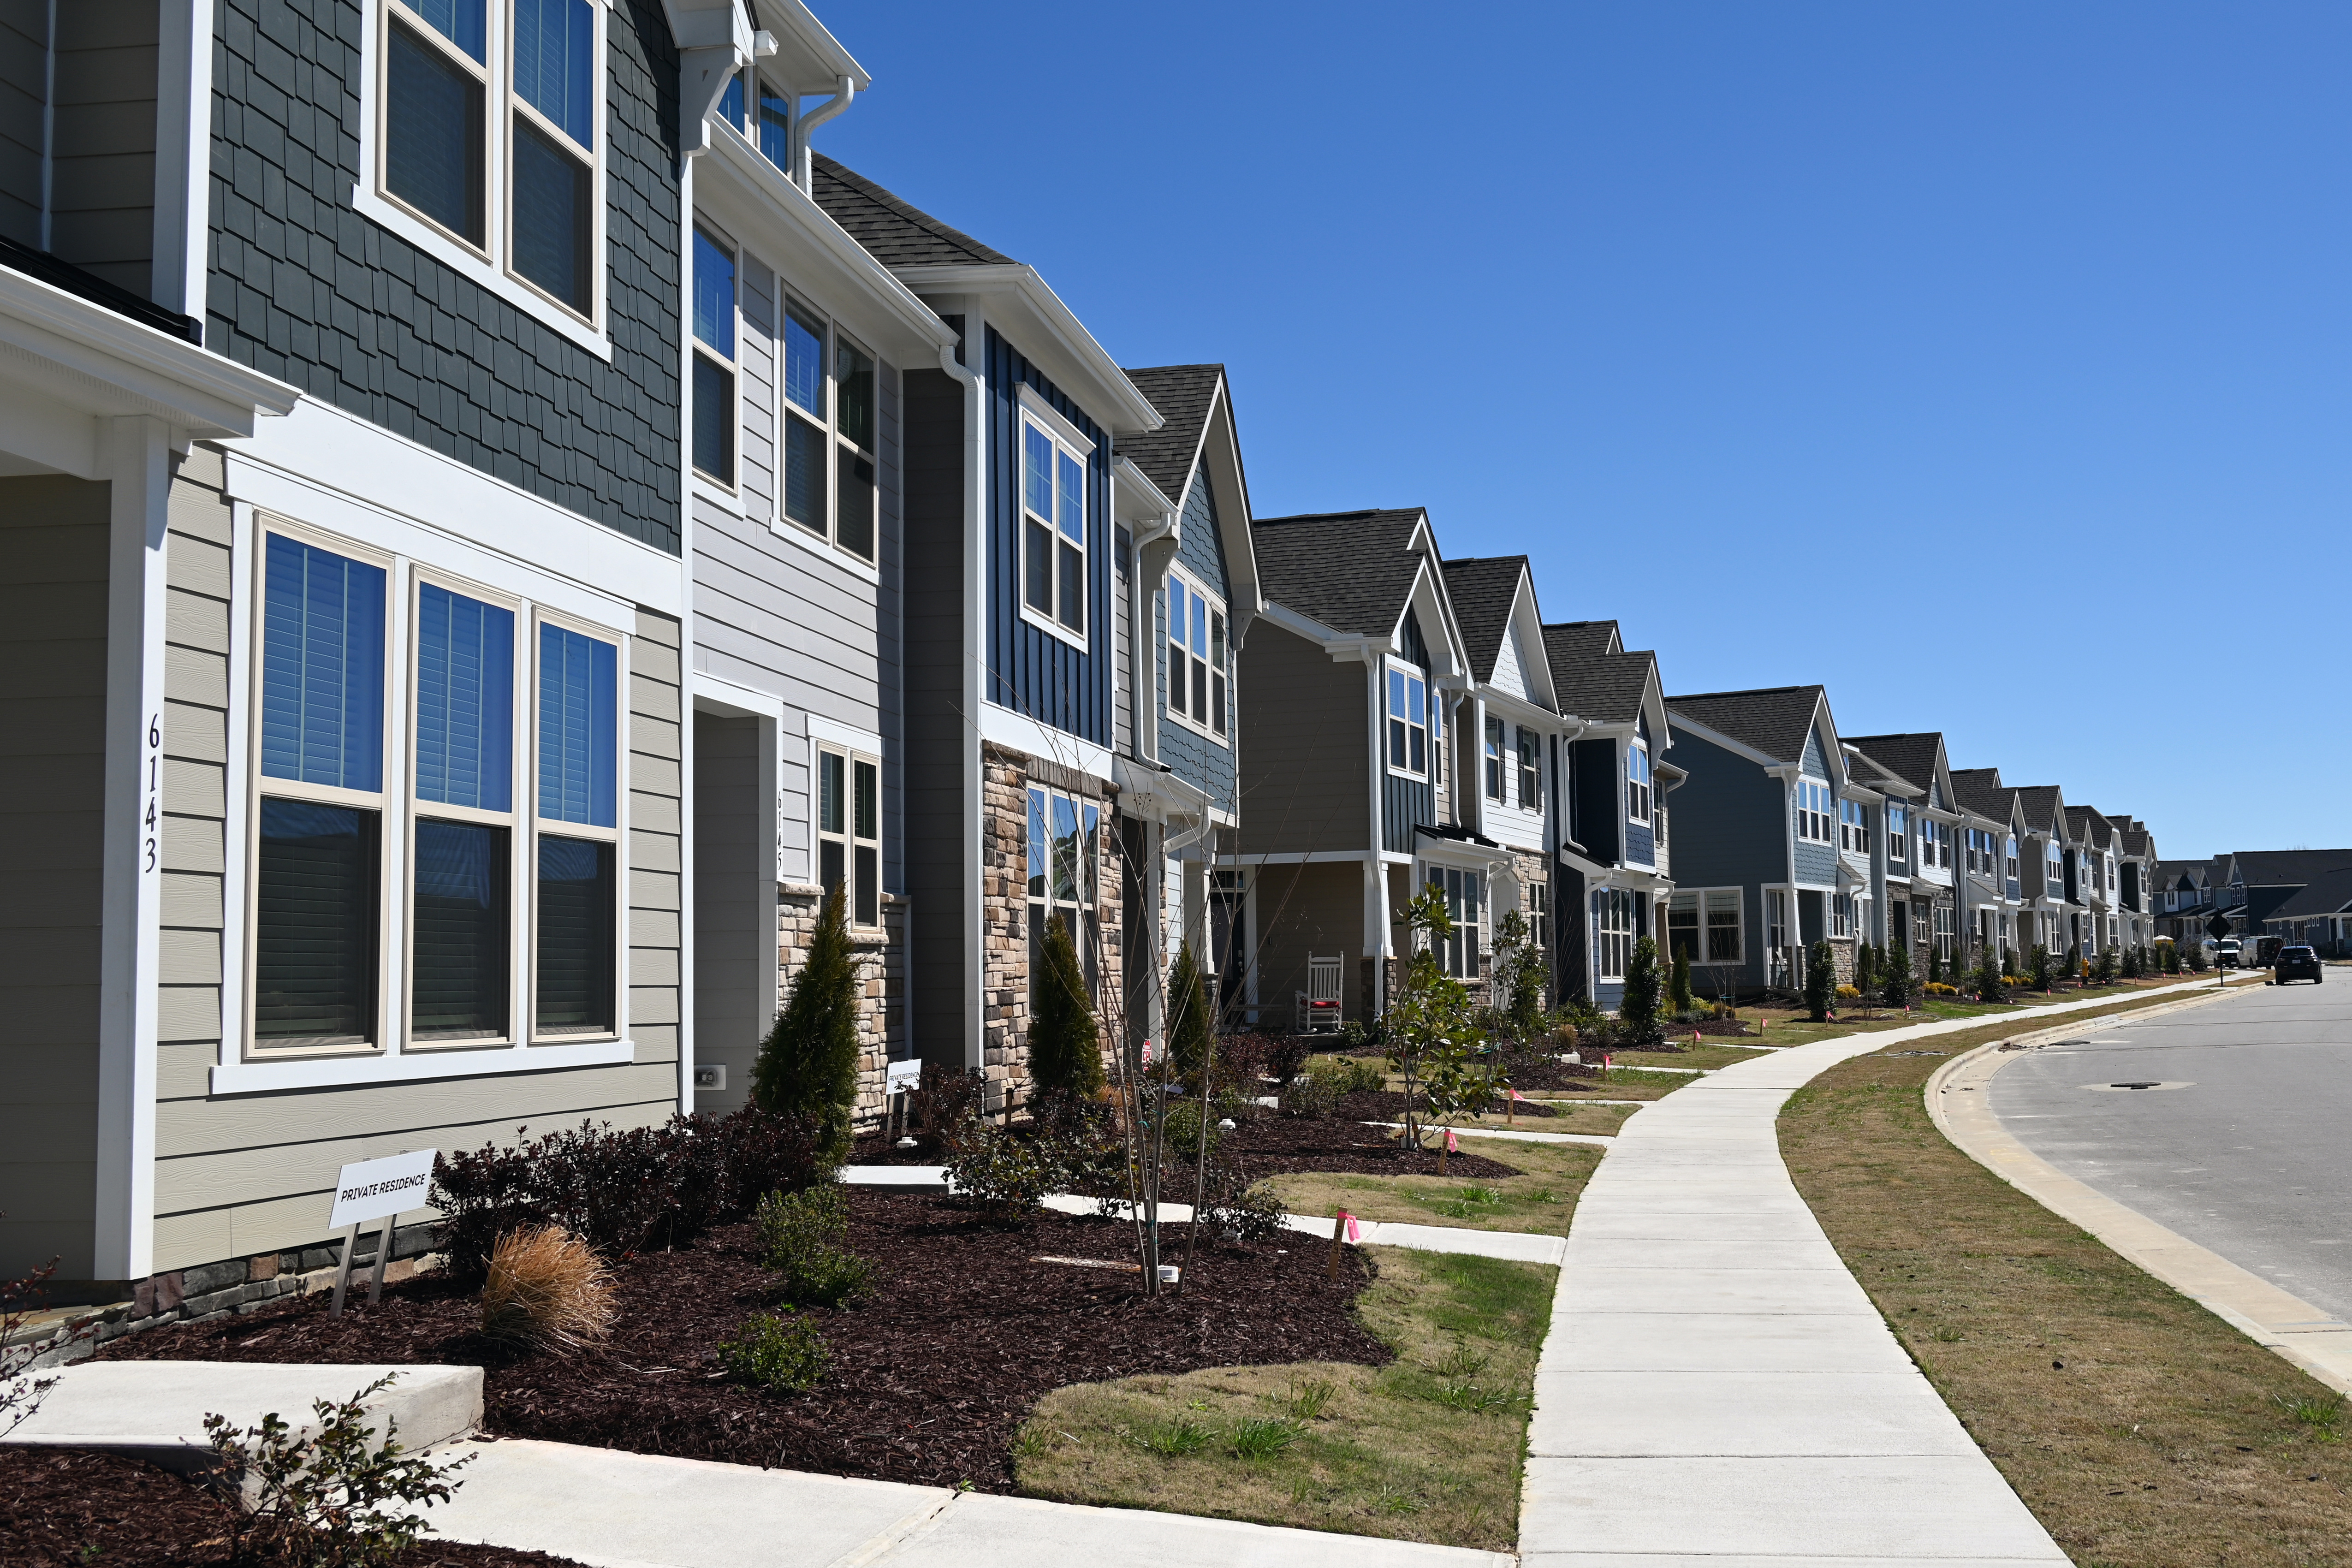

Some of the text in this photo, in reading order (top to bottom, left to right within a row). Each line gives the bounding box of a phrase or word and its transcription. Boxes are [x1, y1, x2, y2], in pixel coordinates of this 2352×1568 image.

[145, 713, 160, 873] 6143
[341, 1173, 426, 1202] PRIVATE RESIDENCE
